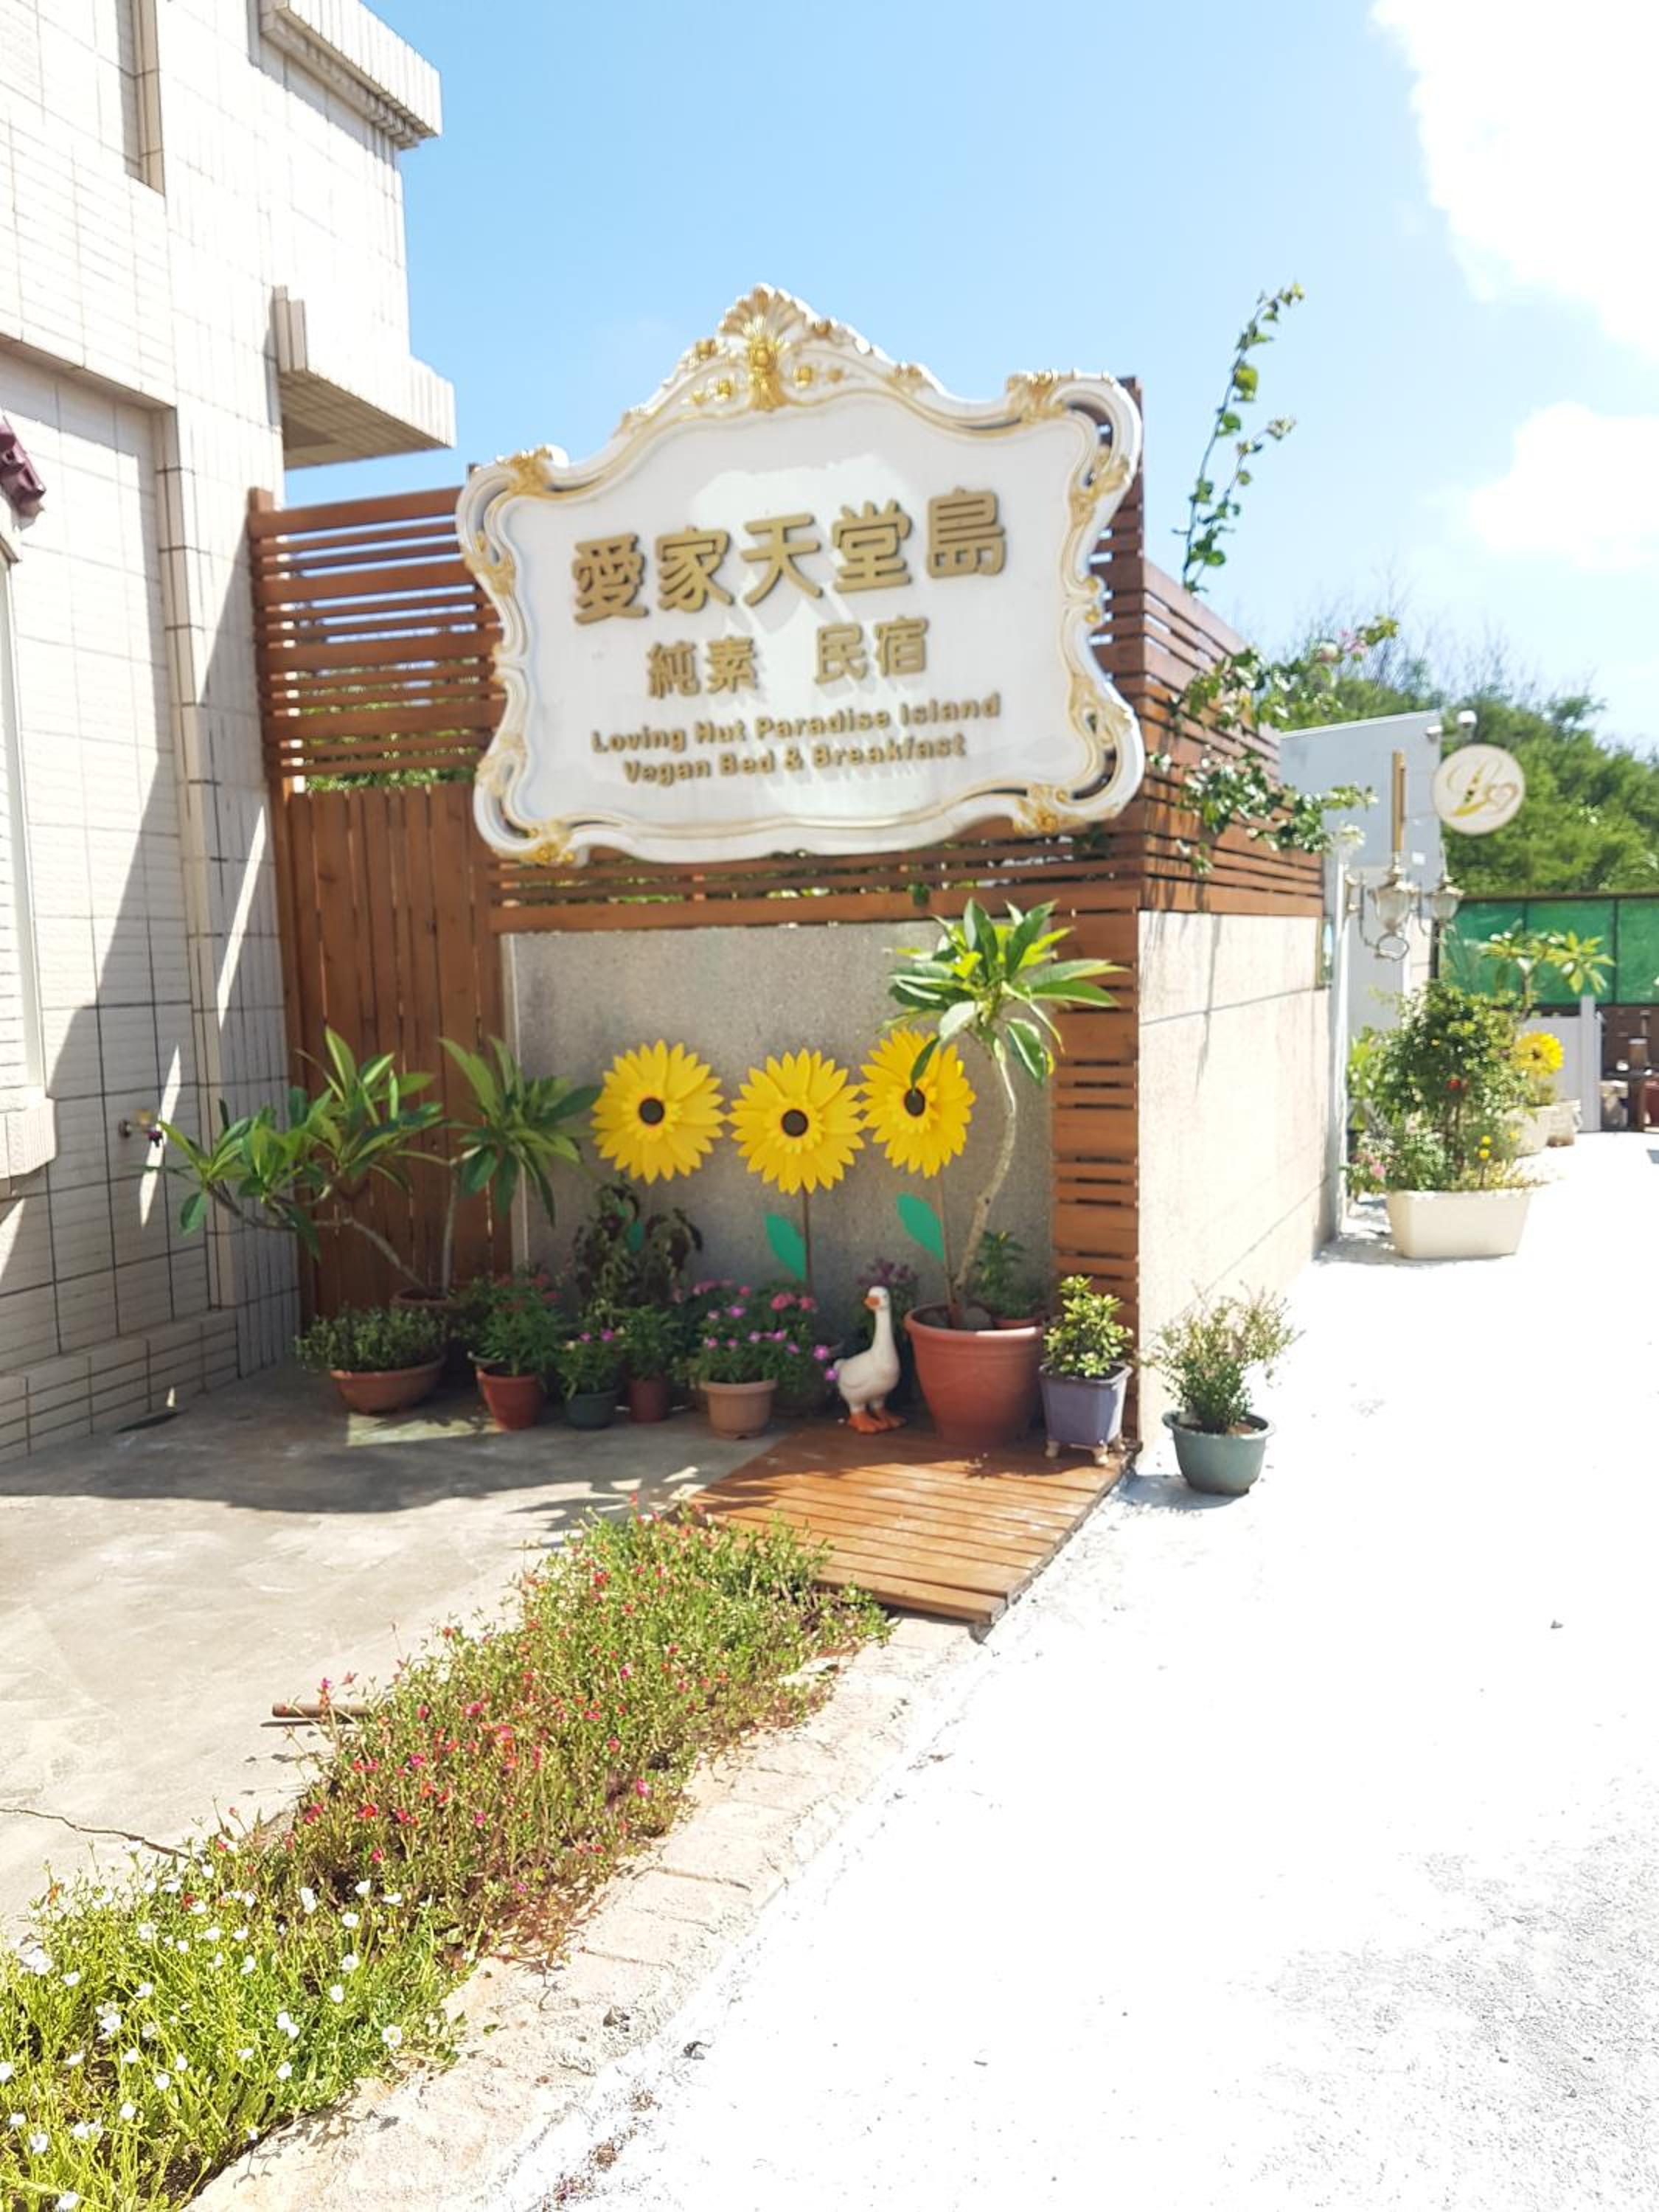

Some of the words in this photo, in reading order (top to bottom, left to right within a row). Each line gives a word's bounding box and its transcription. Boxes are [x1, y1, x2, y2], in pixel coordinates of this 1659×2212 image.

[571, 487, 1006, 625] 愛家天堂島
[646, 635, 757, 699] 純素
[814, 614, 929, 685] 民宿
[591, 726, 686, 753] Loving
[694, 720, 745, 745] Hut
[755, 708, 891, 740] Paradise
[900, 690, 1001, 726] Island
[624, 760, 712, 787] Vegan
[720, 750, 776, 776] Bed
[784, 746, 804, 771] &
[813, 732, 967, 768] Breakfast
